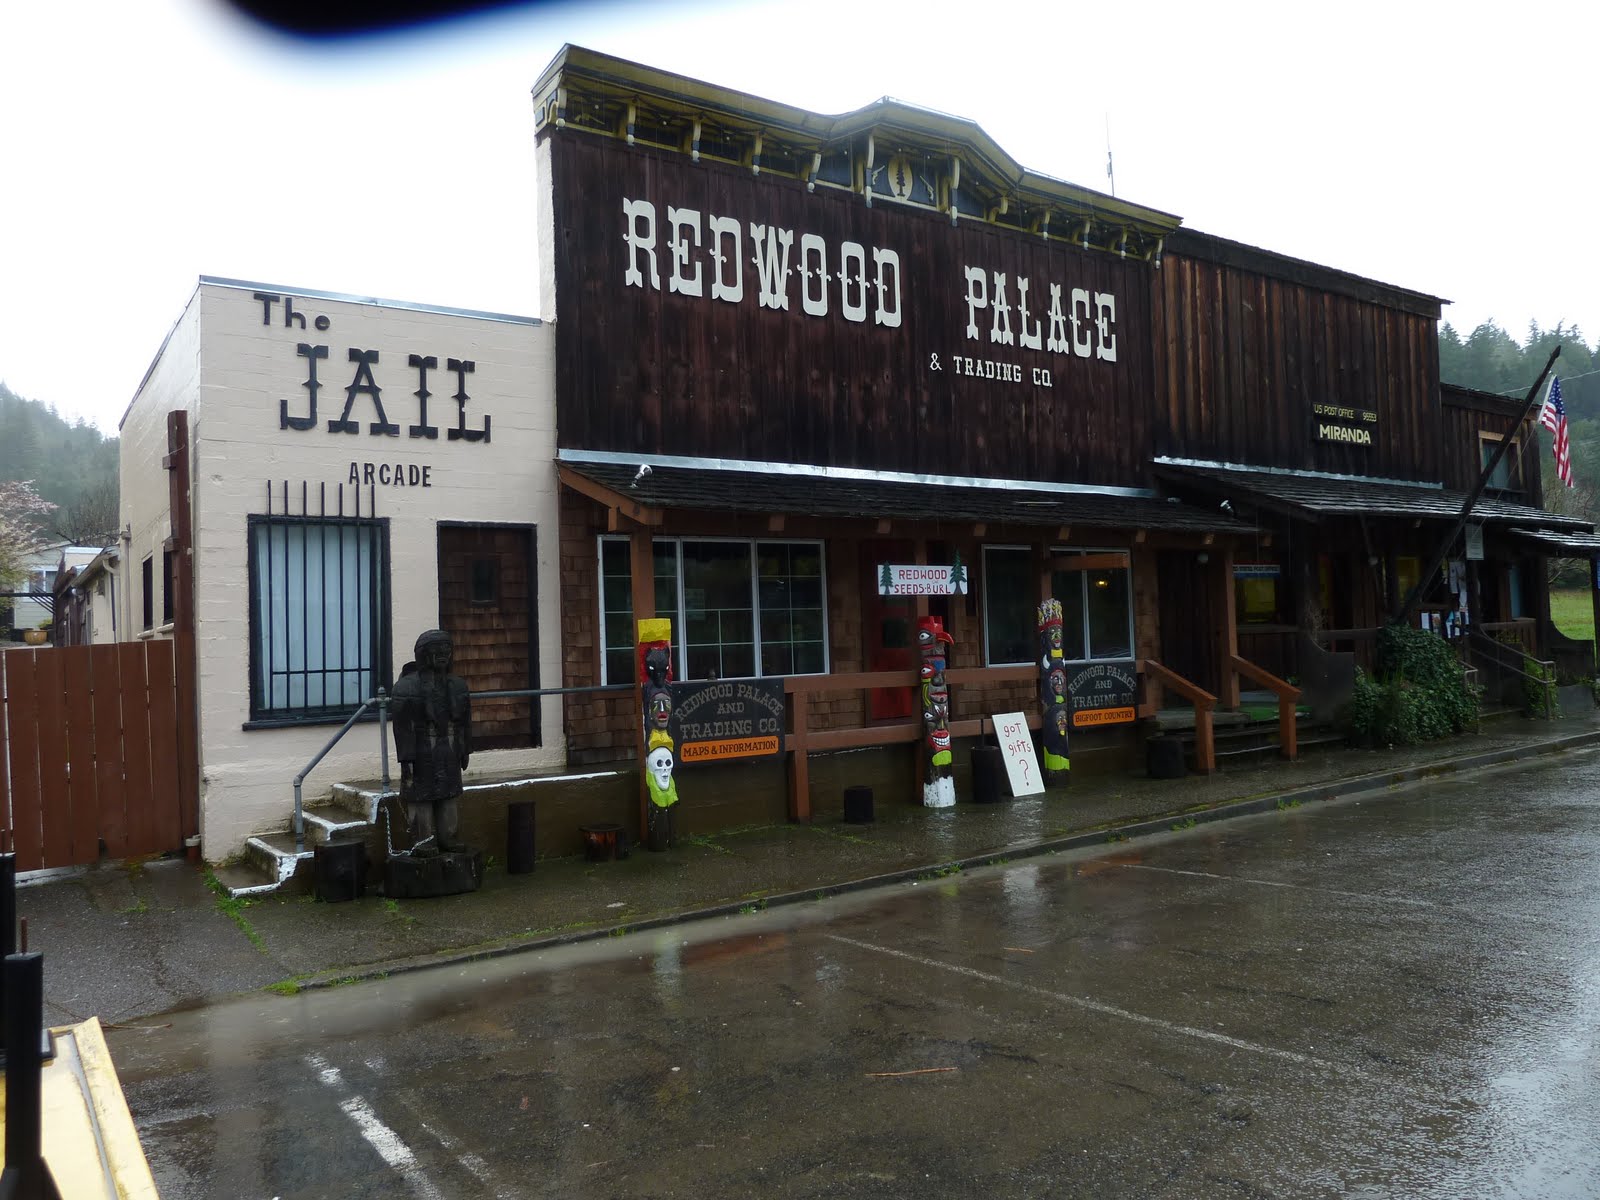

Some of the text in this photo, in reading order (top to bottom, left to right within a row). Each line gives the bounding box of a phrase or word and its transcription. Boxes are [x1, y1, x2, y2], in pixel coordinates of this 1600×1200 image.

[622, 197, 1117, 362] REDWOOD PALACE
[254, 293, 331, 330] The
[930, 352, 942, 371] &
[953, 355, 1022, 383] TRADING
[280, 343, 491, 443] JAIL
[1314, 404, 1322, 414] US
[1324, 406, 1338, 416] POST
[1338, 408, 1354, 419] OFFICE
[1320, 424, 1371, 444] MIRANDA
[349, 462, 432, 487] ARCADE
[898, 569, 948, 580] REDWOOD
[1068, 664, 1137, 694] REDWOOD PALACE
[1095, 679, 1113, 689] AND
[674, 684, 784, 721] REDWOOD PALACE
[717, 702, 745, 714] AND
[1072, 693, 1118, 708] TRADING
[1075, 709, 1133, 723] BIGFOOT COUNTRY
[680, 720, 752, 739] TRADING
[683, 740, 776, 757] MAPS & INFORMATION
[1019, 759, 1029, 786] ?
